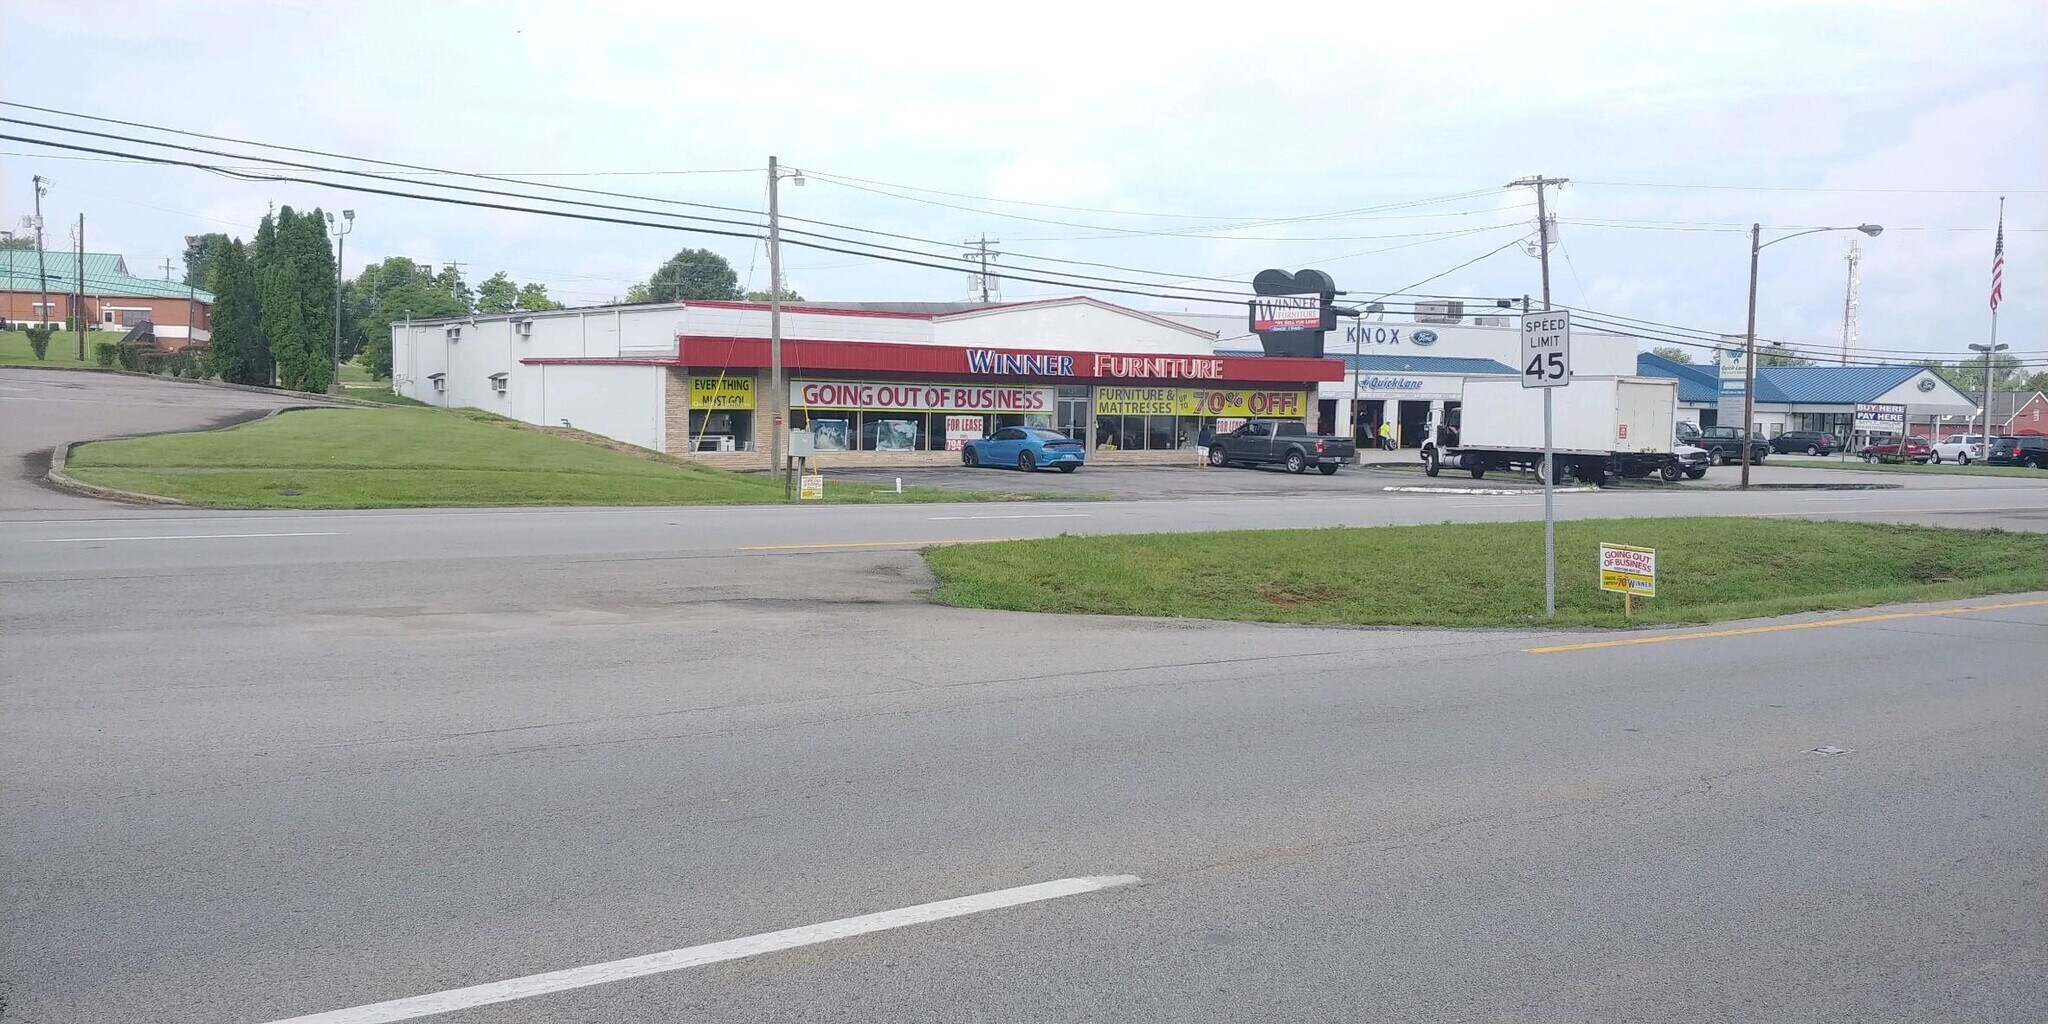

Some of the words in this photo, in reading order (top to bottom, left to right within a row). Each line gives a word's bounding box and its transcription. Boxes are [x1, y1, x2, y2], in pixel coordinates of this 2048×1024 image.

[1259, 298, 1316, 321] WINNER
[1278, 310, 1317, 318] FURNITURE
[1525, 319, 1565, 333] SPEED
[1346, 327, 1400, 344] KNOX
[1530, 335, 1560, 348] LIMIT
[966, 349, 1075, 376] WINNER
[1093, 354, 1224, 379] FURNITURE
[1525, 352, 1565, 380] 45
[1371, 377, 1397, 389] Quick
[1399, 377, 1424, 389] Lane
[803, 384, 873, 406] GOING
[877, 386, 921, 407] OUT
[925, 388, 951, 408] OF
[954, 388, 1044, 410] BUSINESS
[1099, 388, 1164, 401] FURNITURE
[1166, 389, 1175, 401] &
[1178, 394, 1188, 403] UP
[1099, 402, 1172, 414] MATTRESSES
[1180, 402, 1189, 410] TO
[1193, 391, 1243, 415] 70%
[1248, 391, 1298, 415] OFF!
[1879, 405, 1905, 413] HERE
[1877, 413, 1904, 421] HERE
[947, 419, 960, 431] FOR
[962, 419, 982, 431] LEASE
[1217, 421, 1228, 432] FOR
[1604, 551, 1632, 559] GOING
[1632, 553, 1652, 564] OUT
[1615, 559, 1652, 572] BUSINESS
